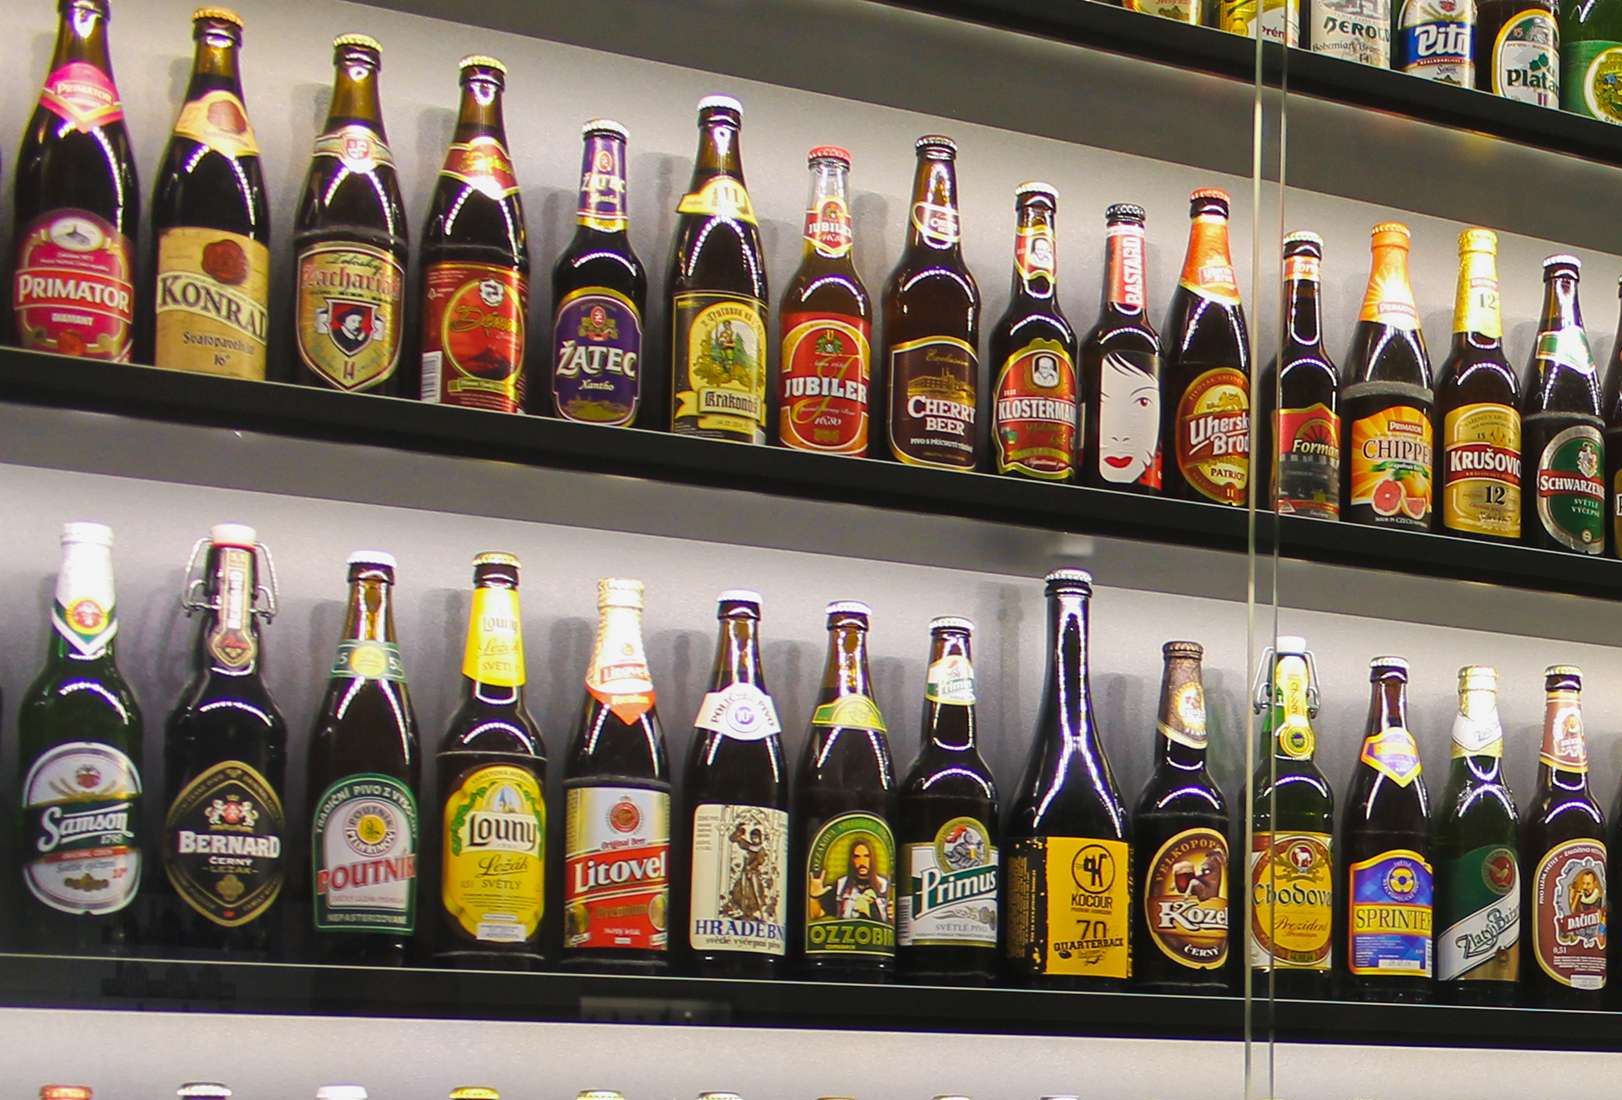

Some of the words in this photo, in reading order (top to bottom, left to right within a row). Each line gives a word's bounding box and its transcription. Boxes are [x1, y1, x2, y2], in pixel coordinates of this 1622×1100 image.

[18, 273, 130, 313] PRIMATOR
[557, 340, 637, 378] ŽATEC
[785, 377, 868, 405] JUBILER
[906, 395, 977, 420] CHERRY
[925, 417, 966, 436] BEER
[1210, 468, 1246, 483] PATRIOT
[1484, 485, 1506, 505] 12
[353, 784, 382, 798] PIVO
[37, 803, 134, 854] Samson
[468, 813, 537, 860] Louny
[178, 829, 281, 860] BERNARD
[316, 850, 417, 895] POUTNÍK
[476, 856, 529, 876] Ležák
[573, 848, 668, 895] Litovel
[919, 868, 997, 917] Primus
[1071, 893, 1113, 911] KOCOUR
[1158, 900, 1229, 933] Kozel
